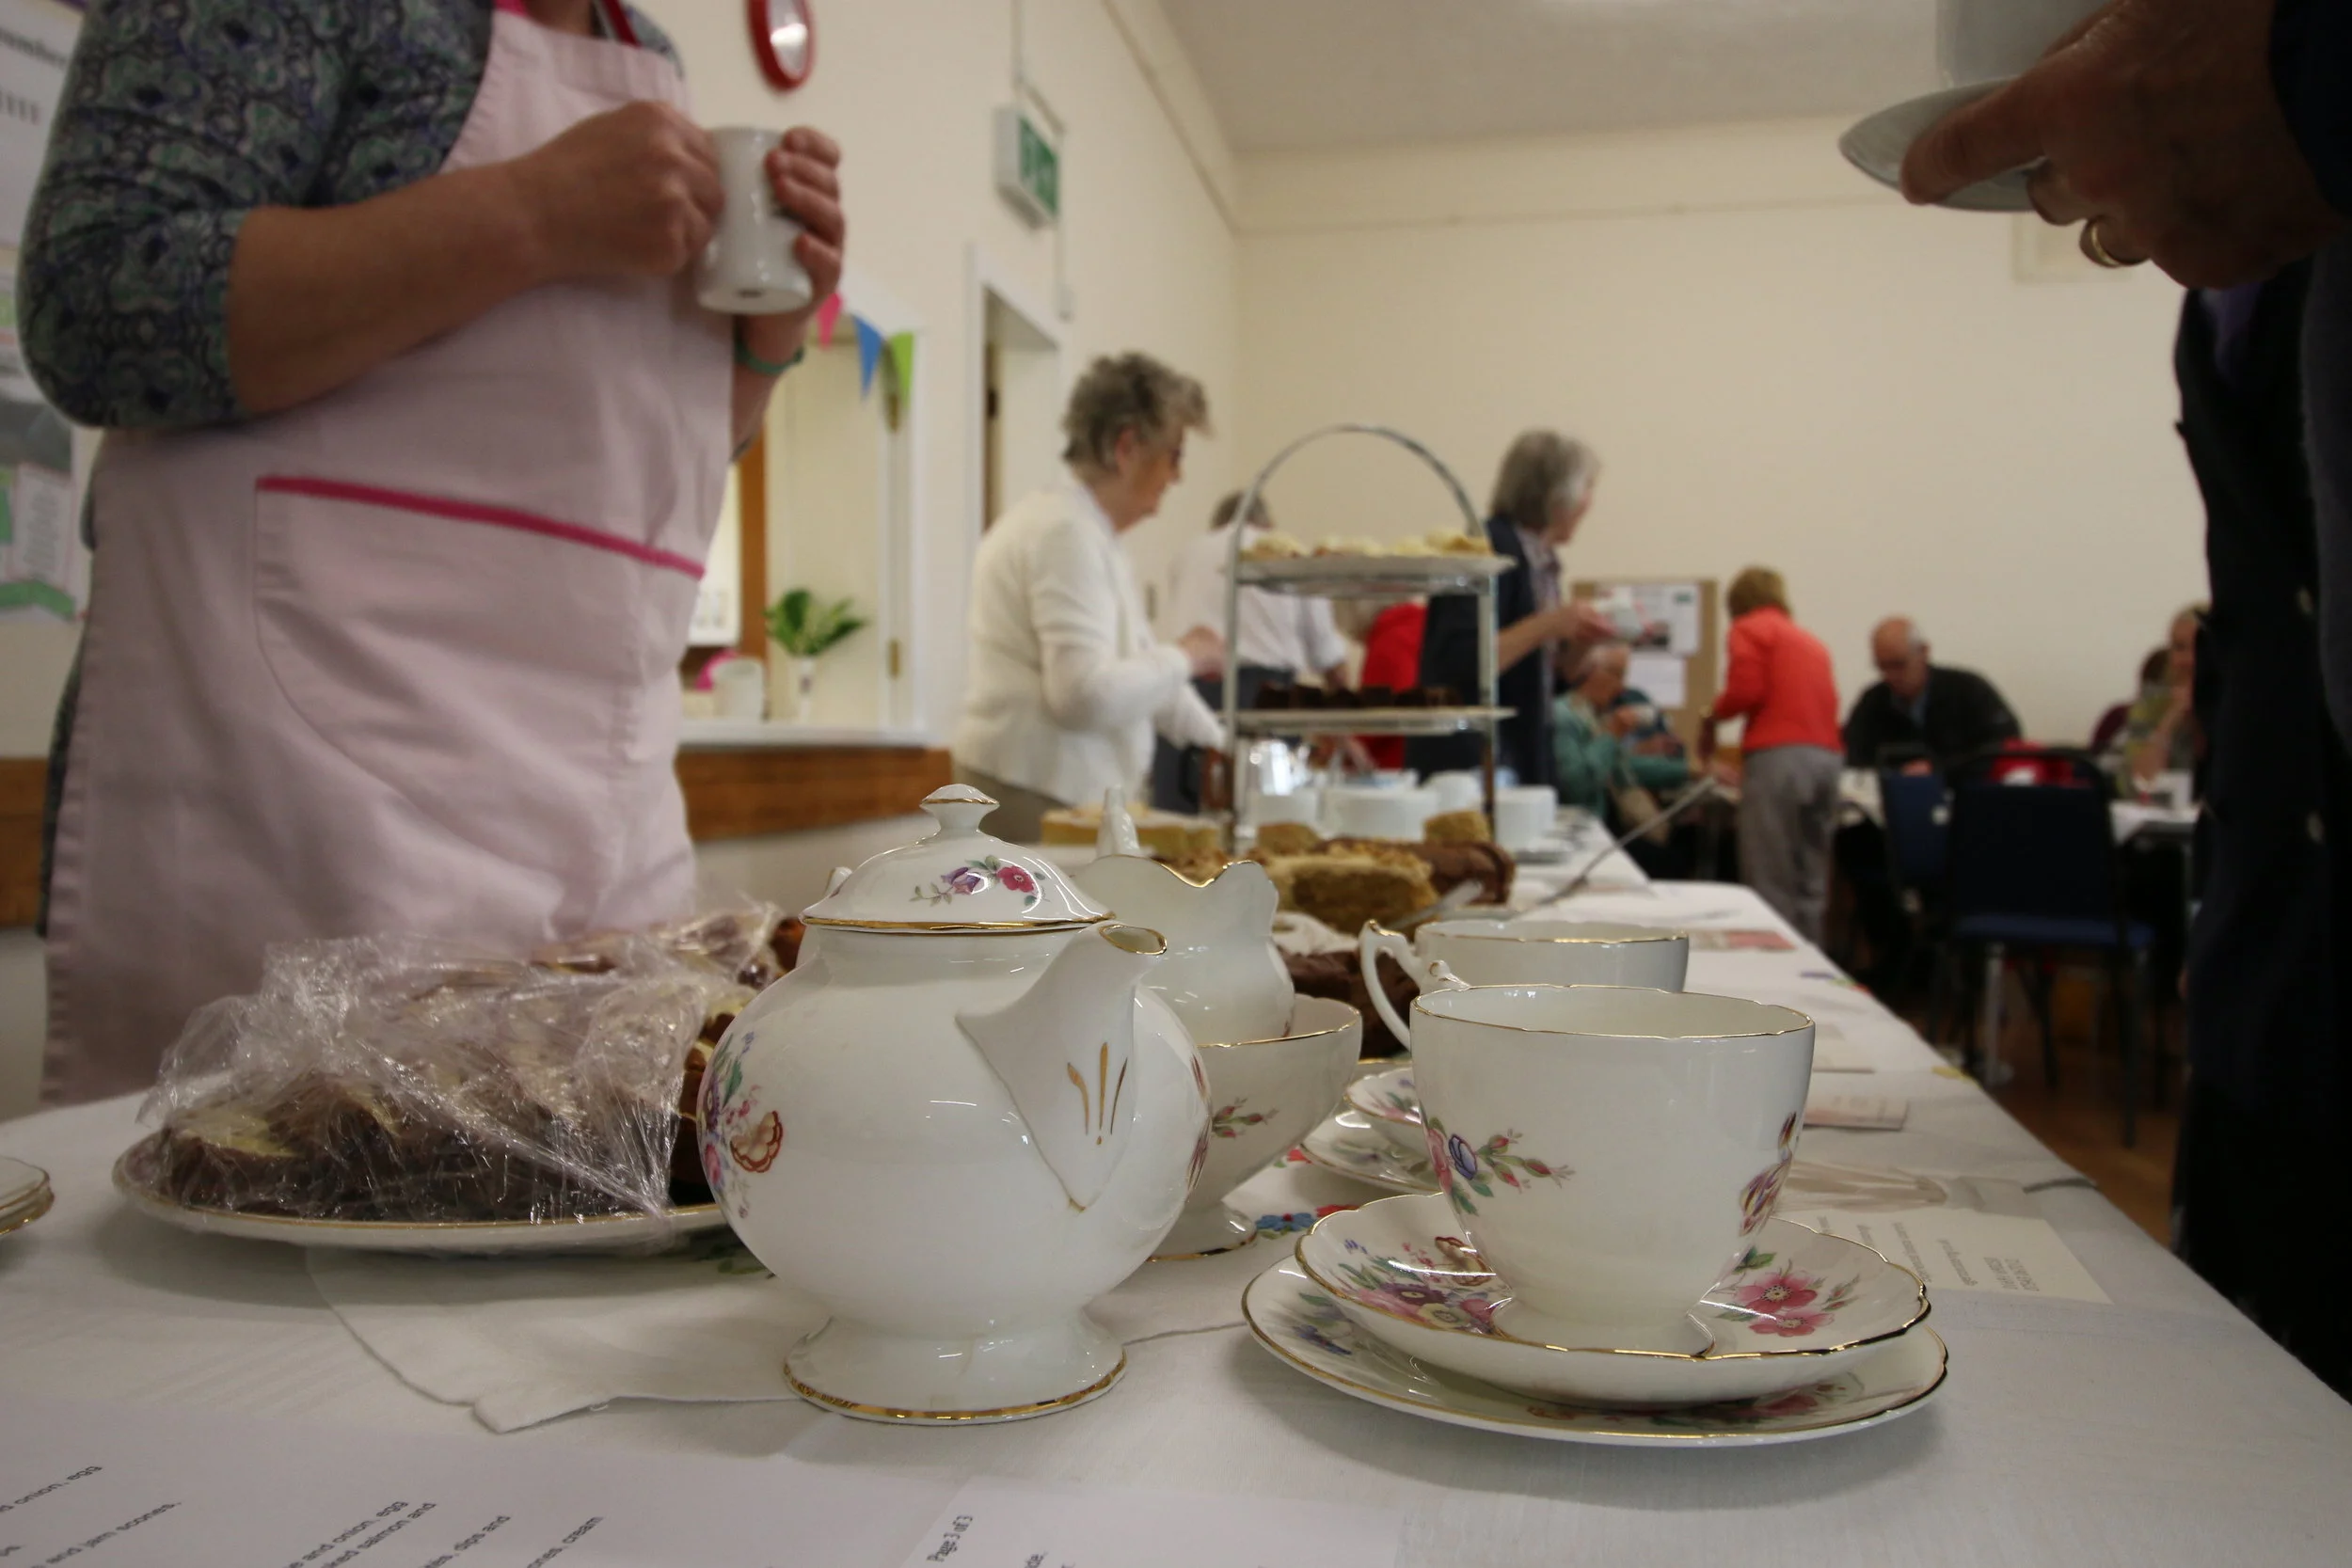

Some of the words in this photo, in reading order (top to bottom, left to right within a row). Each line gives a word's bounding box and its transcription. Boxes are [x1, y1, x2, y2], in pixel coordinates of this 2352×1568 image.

[67, 1465, 103, 1481] egg
[302, 1544, 335, 1561] and
[376, 1500, 409, 1517] egg
[357, 1519, 410, 1549] salmon
[406, 1502, 437, 1519] and
[453, 1532, 486, 1552] dips
[482, 1515, 512, 1532] and
[562, 1516, 604, 1544] cream
[926, 1540, 958, 1562] Page
